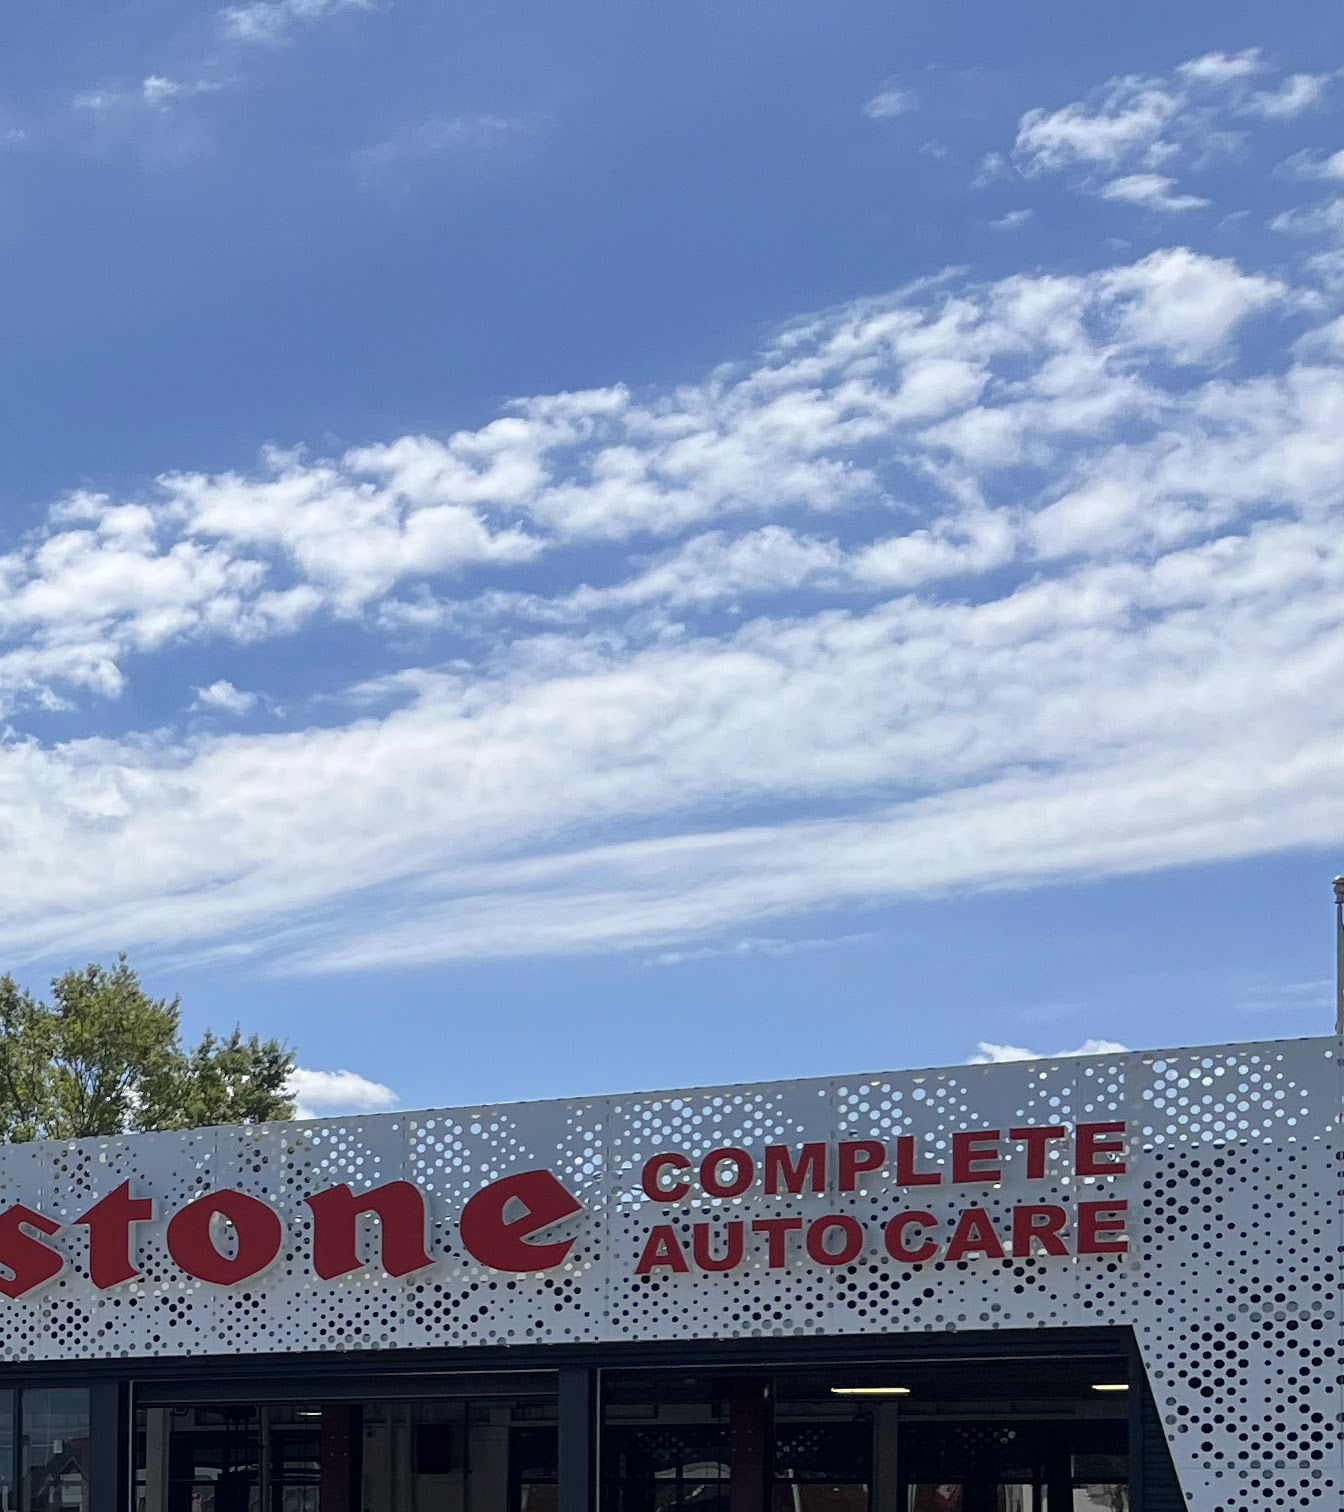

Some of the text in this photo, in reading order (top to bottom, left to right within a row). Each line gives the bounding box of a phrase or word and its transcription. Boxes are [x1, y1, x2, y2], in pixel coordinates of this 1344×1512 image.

[641, 1121, 1127, 1202] COMPLETE
[633, 1200, 1129, 1275] AUTO CARE
